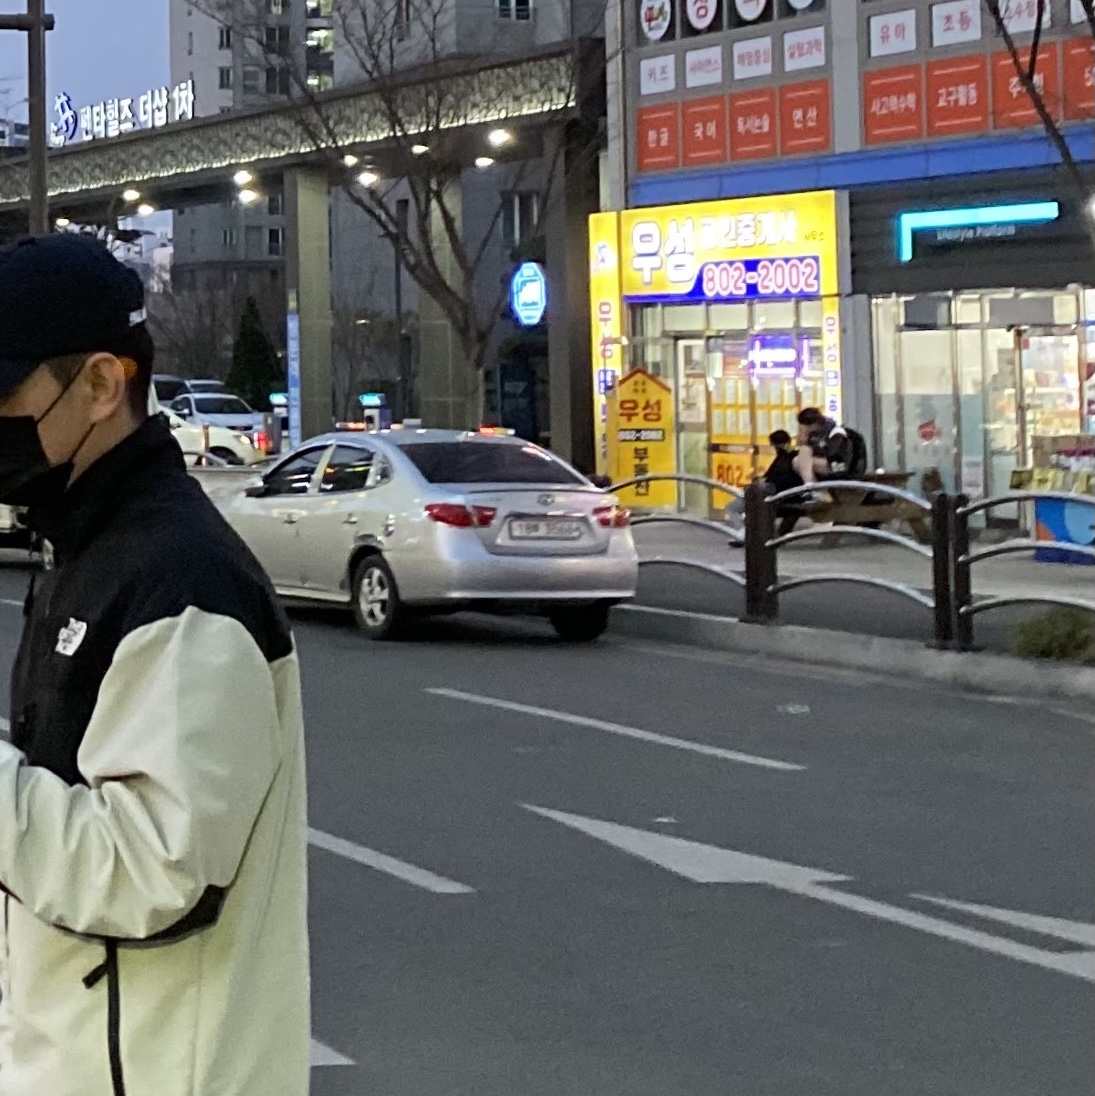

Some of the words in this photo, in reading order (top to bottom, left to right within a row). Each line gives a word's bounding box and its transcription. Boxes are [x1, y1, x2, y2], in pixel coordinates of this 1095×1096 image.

[880, 22, 906, 44] 유아
[942, 10, 971, 32] 초등
[80, 98, 134, 142] 펜타힐즈
[139, 86, 168, 128] 더샵
[172, 79, 194, 120] 1차
[792, 106, 818, 129] 연산
[693, 119, 717, 141] 국어
[632, 215, 695, 285] 우성
[702, 259, 819, 297] 802-2002
[618, 398, 663, 424] 우성
